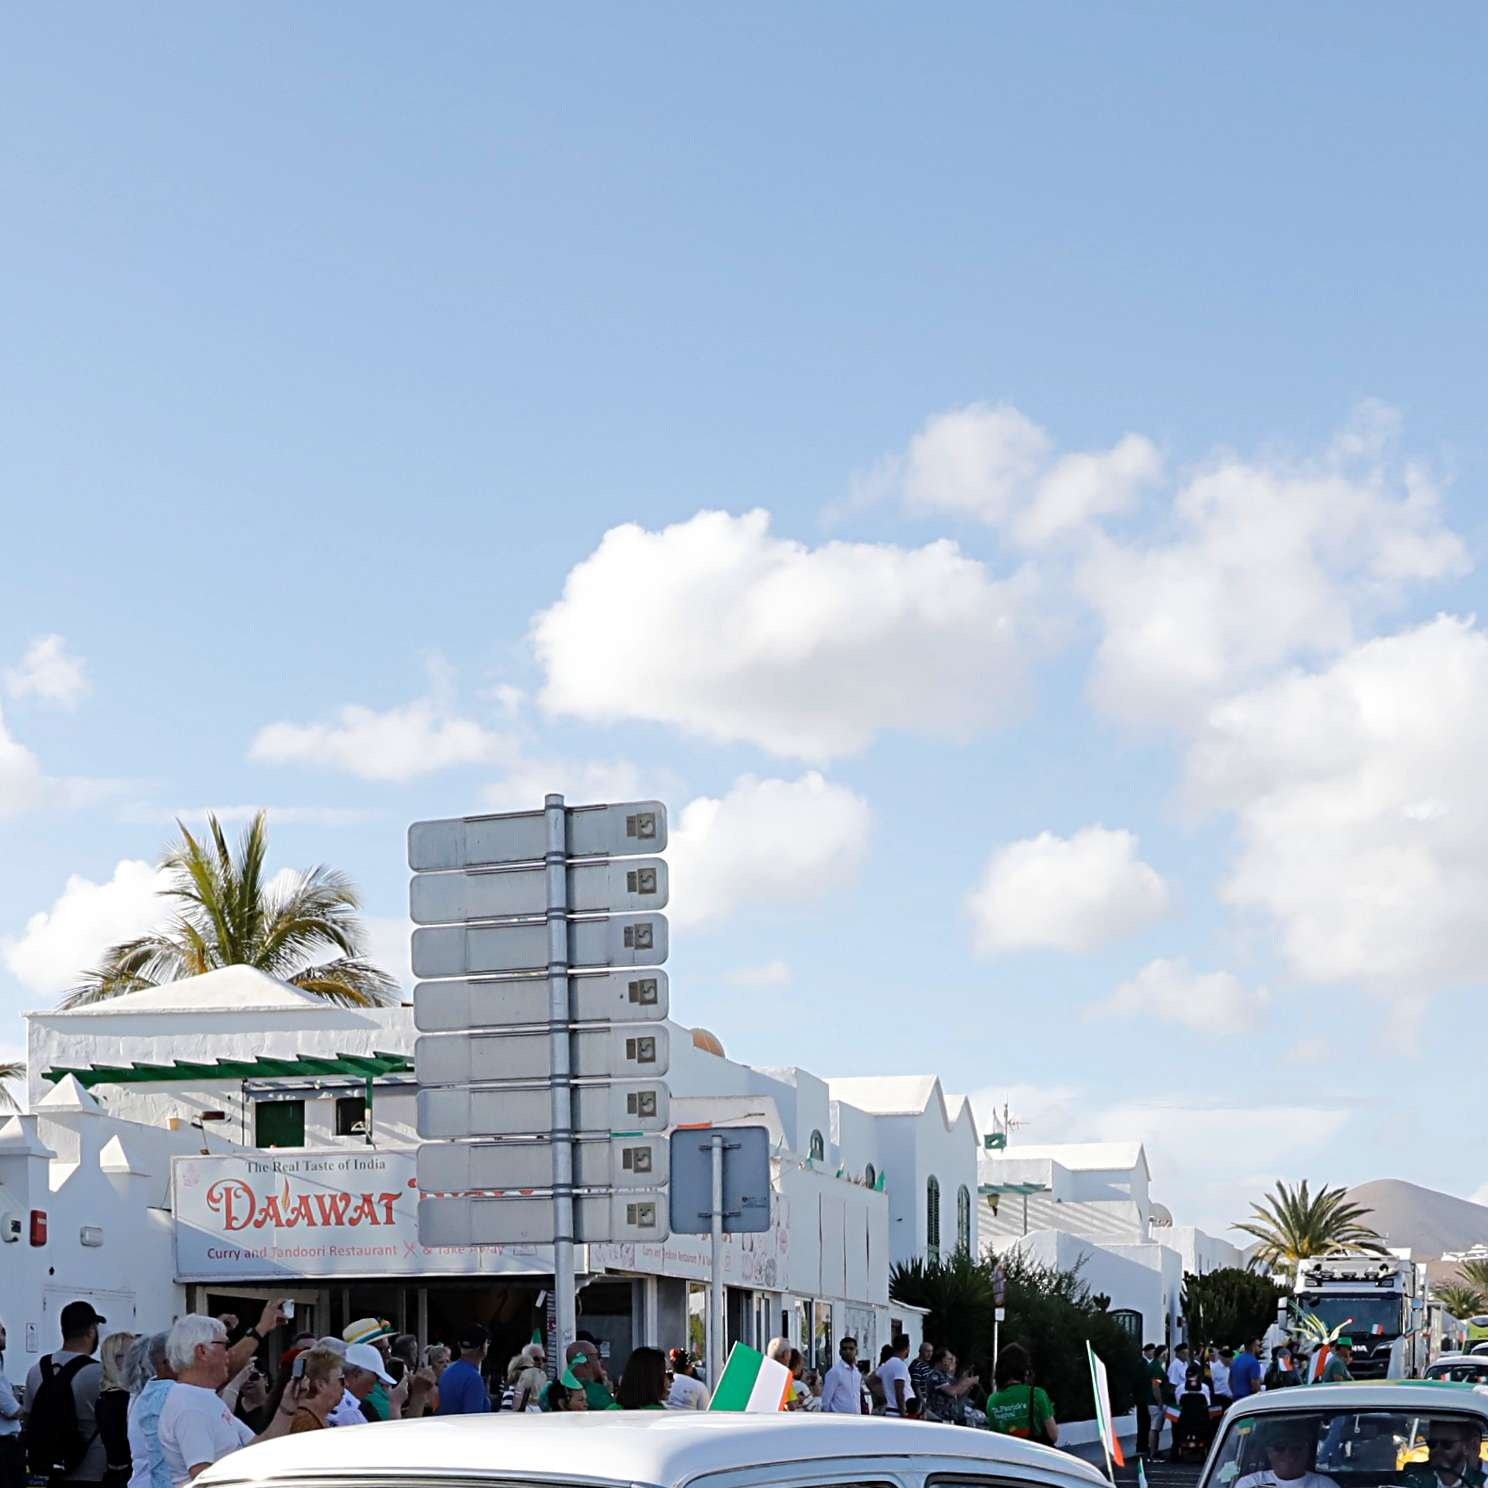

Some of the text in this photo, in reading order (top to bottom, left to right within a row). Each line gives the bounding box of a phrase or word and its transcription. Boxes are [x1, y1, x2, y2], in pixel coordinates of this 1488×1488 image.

[247, 1157, 386, 1173] The Real Taste of India
[207, 1247, 241, 1261] Curry
[244, 1247, 267, 1259] and
[330, 1244, 397, 1257] Restaurant
